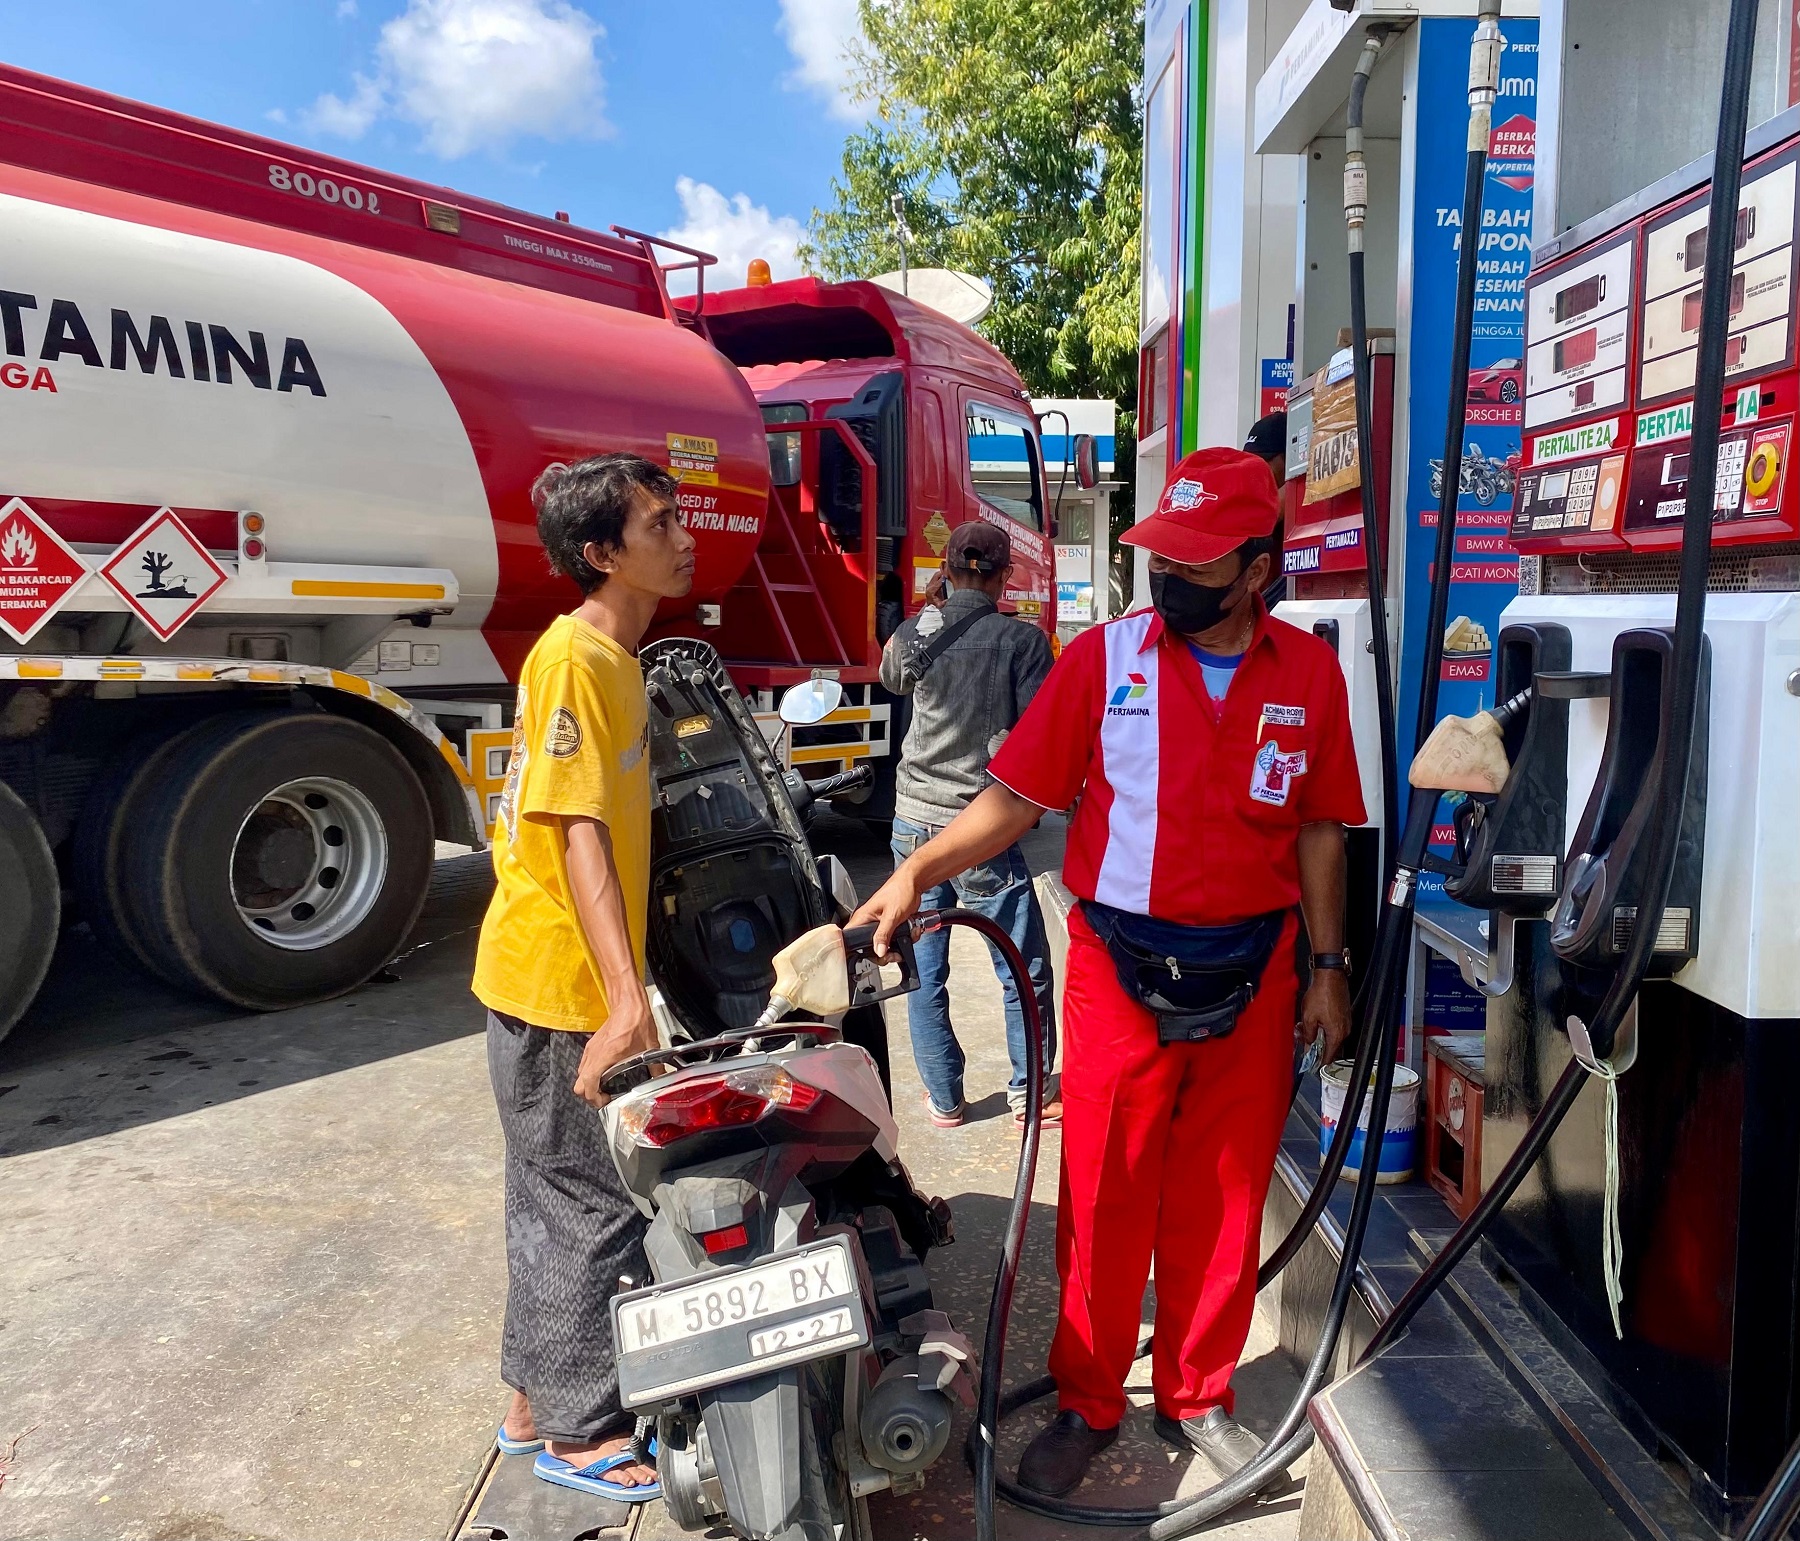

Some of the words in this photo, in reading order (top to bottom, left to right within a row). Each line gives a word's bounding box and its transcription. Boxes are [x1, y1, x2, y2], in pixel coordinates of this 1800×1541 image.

[1485, 162, 1535, 175] MyPERTA
[1436, 208, 1531, 227] TABAH
[503, 234, 544, 255] TINGGI
[545, 246, 570, 262] MAX
[571, 252, 614, 273] 3550mm
[1676, 252, 1685, 262] Rp
[1456, 260, 1525, 274] MBAH
[1474, 298, 1525, 312] ENAN
[1472, 326, 1513, 336] HINGGA
[0, 289, 328, 398] TAMINA
[1287, 378, 1294, 386] P
[1736, 389, 1758, 420] 1A
[1638, 405, 1692, 441] PERTAL
[1538, 429, 1594, 459] PERTALITE
[1596, 424, 1612, 447] 2A
[1755, 430, 1786, 443] EMERGENCY
[684, 438, 707, 452] AWAS
[1313, 429, 1357, 482] HABIS
[671, 459, 693, 469] BLIND
[695, 462, 715, 472] SPOT
[703, 497, 718, 510] BY
[1755, 498, 1768, 506] STOP
[690, 511, 725, 531] PATRA
[725, 514, 759, 534] NIAGA
[978, 503, 1010, 532] DILARANG
[1424, 515, 1464, 524] TRIH
[1467, 514, 1511, 524] BONNEVI
[1009, 523, 1044, 552] MENUMPANG
[1326, 533, 1351, 549] PERTAMAX
[1466, 539, 1495, 550] BMW
[1497, 539, 1504, 550] R
[1068, 548, 1088, 558] BNI
[1284, 546, 1320, 572] PERTAMAX
[0, 587, 39, 597] MUDAH
[1058, 584, 1076, 593] ATM
[1449, 664, 1484, 677] EMAS
[1107, 706, 1150, 717] PERTAMINA
[636, 1307, 660, 1347] M
[683, 1279, 769, 1333] 5892
[788, 1260, 835, 1305] BX
[648, 1341, 705, 1363] HONDA
